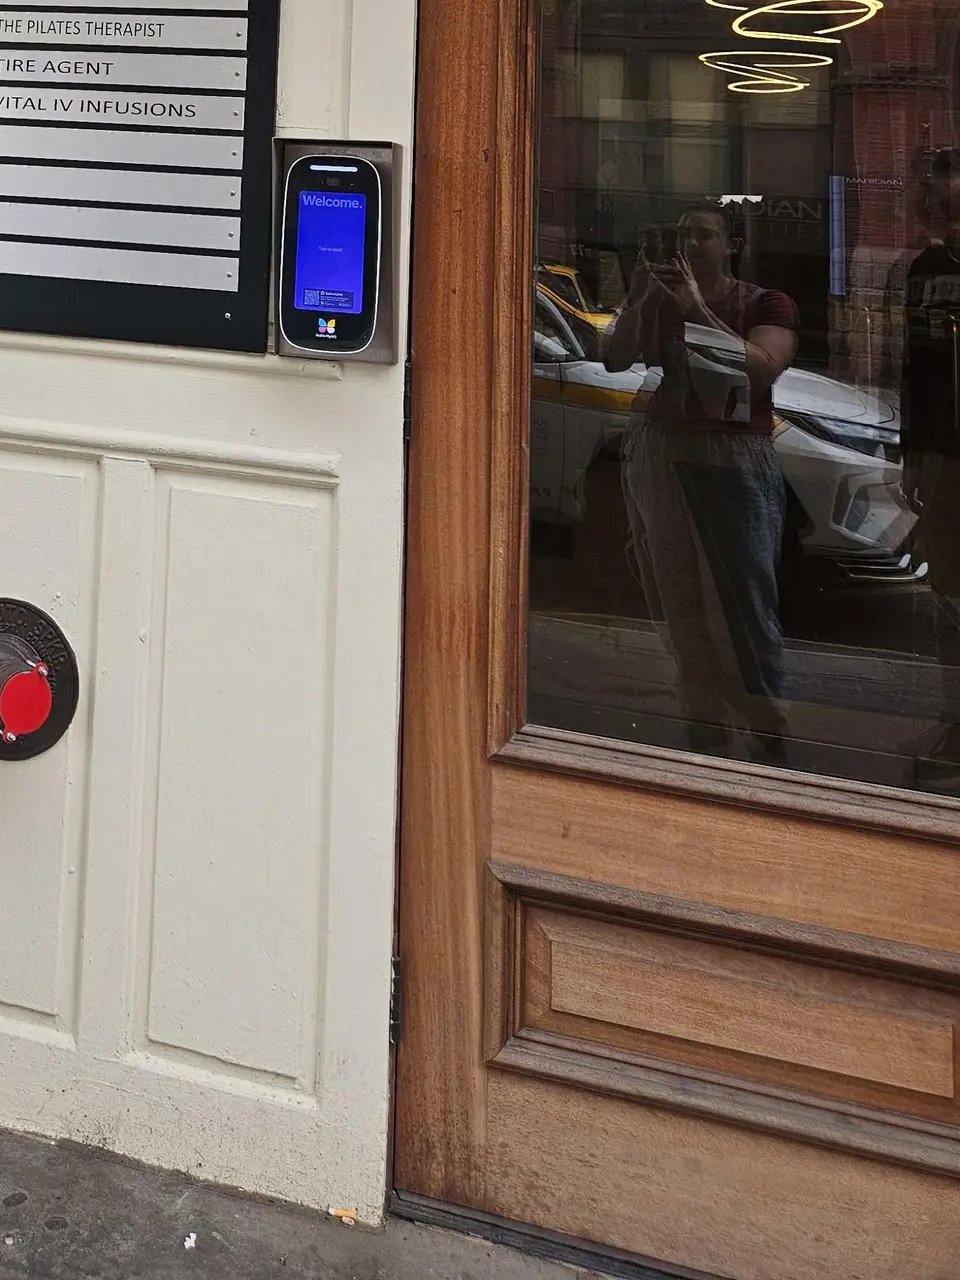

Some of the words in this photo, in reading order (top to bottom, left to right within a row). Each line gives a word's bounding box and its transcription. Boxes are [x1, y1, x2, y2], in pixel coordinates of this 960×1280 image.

[28, 20, 80, 35] PILATES
[85, 22, 164, 37] THERAPIST
[42, 61, 113, 75] AGENT
[54, 99, 73, 111] IV
[81, 100, 195, 117] INFUSIONS
[302, 194, 363, 209] Welcome.
